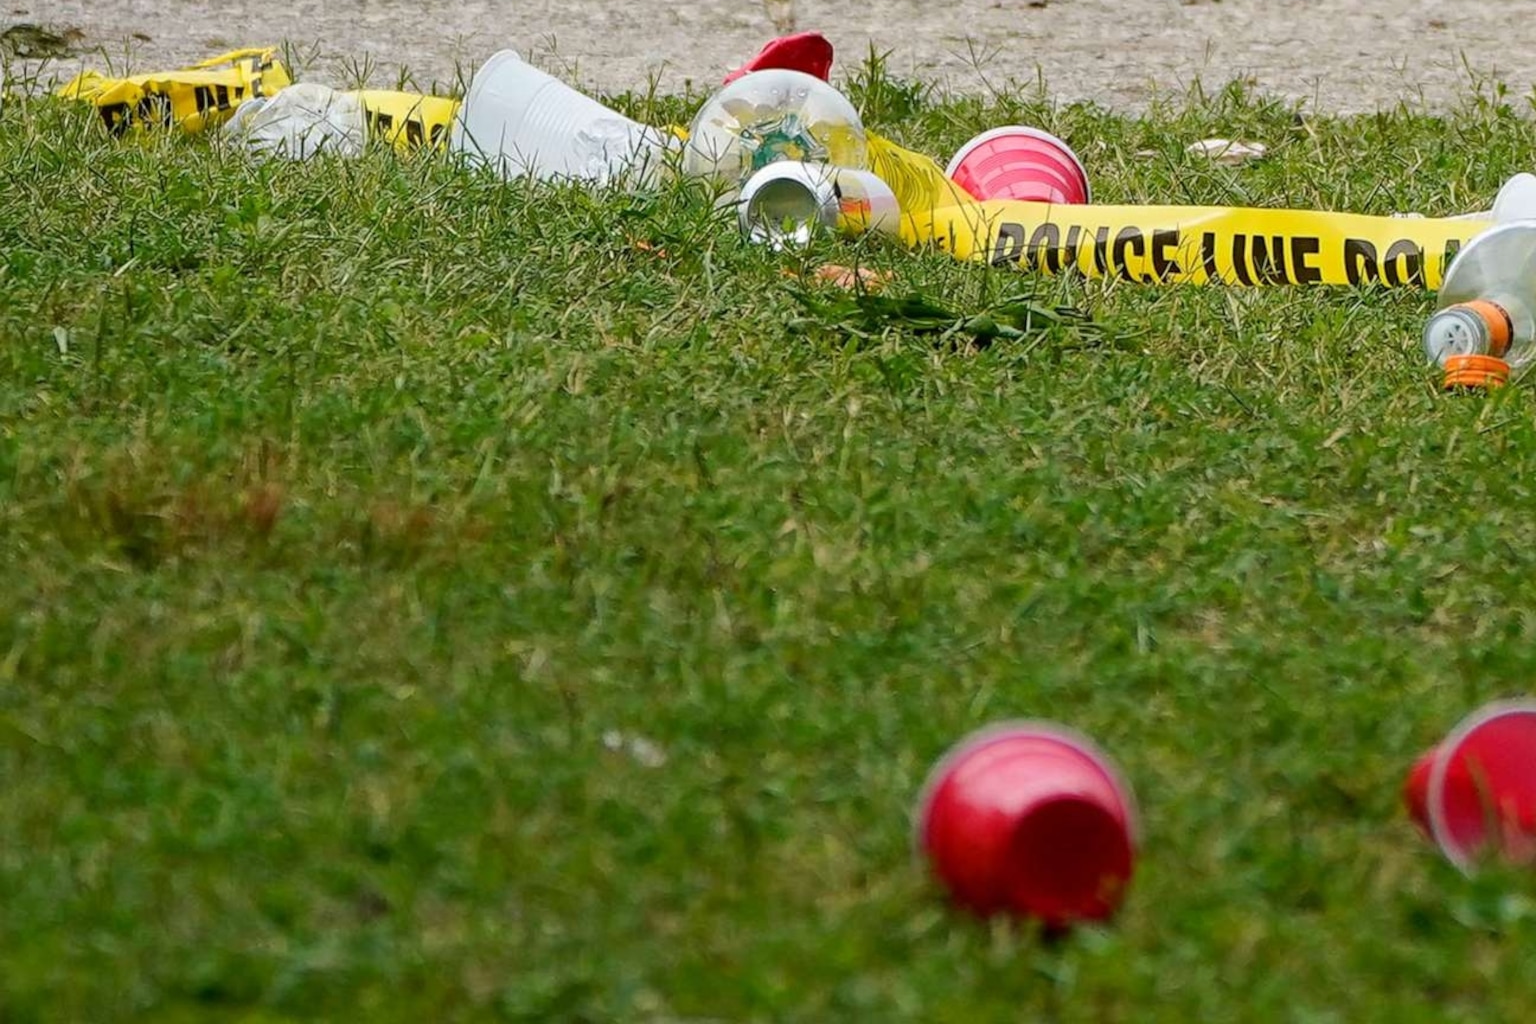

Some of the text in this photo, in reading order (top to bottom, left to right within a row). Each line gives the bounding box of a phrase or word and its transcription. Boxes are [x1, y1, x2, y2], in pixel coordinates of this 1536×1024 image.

[991, 222, 1181, 285] POLICE
[1200, 232, 1321, 287] LINE
[1344, 238, 1424, 288] DO
